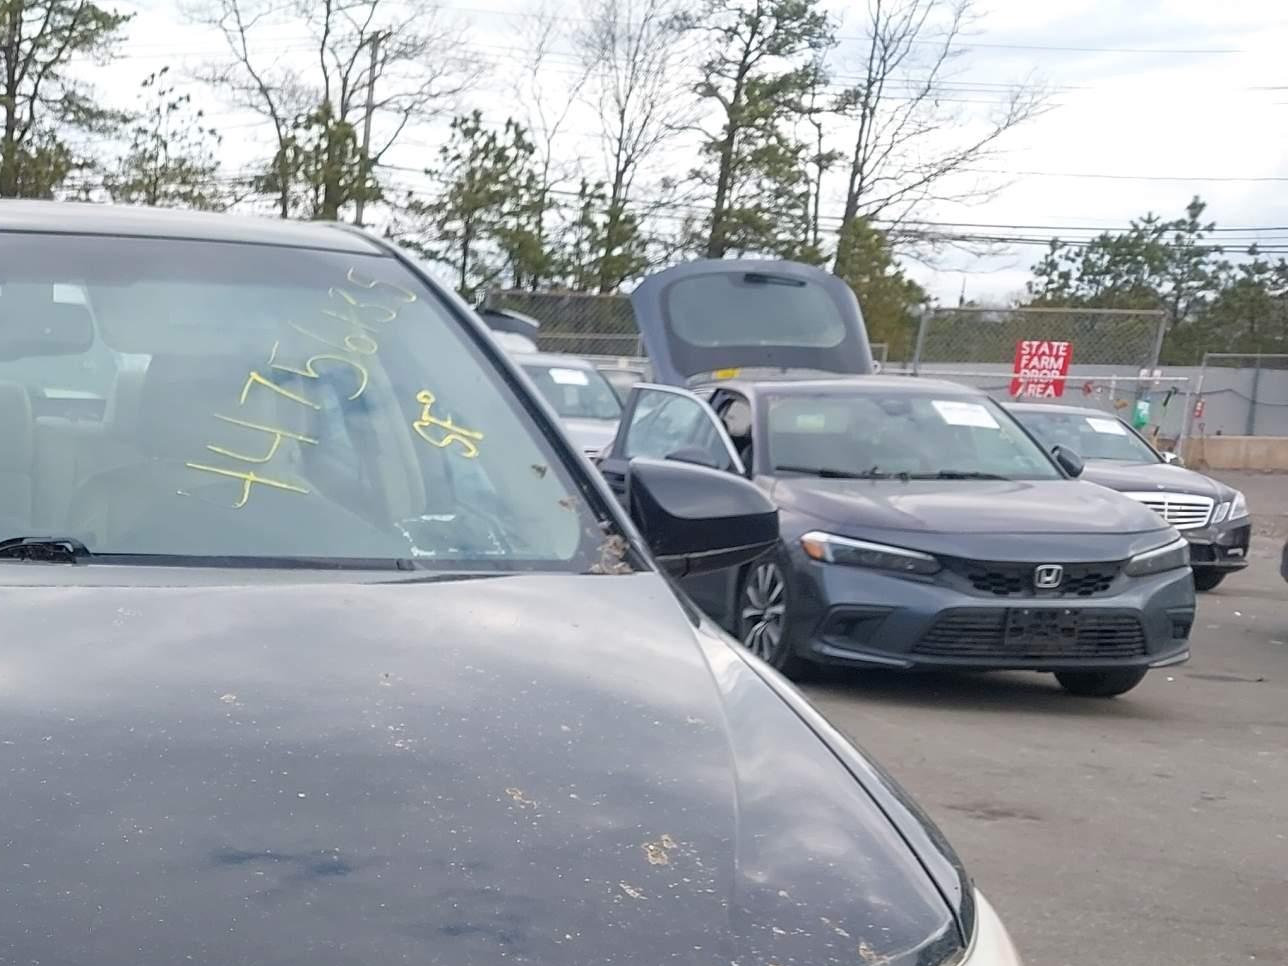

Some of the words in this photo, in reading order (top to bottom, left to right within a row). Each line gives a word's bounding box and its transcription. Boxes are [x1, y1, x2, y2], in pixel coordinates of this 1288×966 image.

[1021, 341, 1069, 356] STATE
[1020, 355, 1064, 370] FARM
[1019, 369, 1060, 383] DROP
